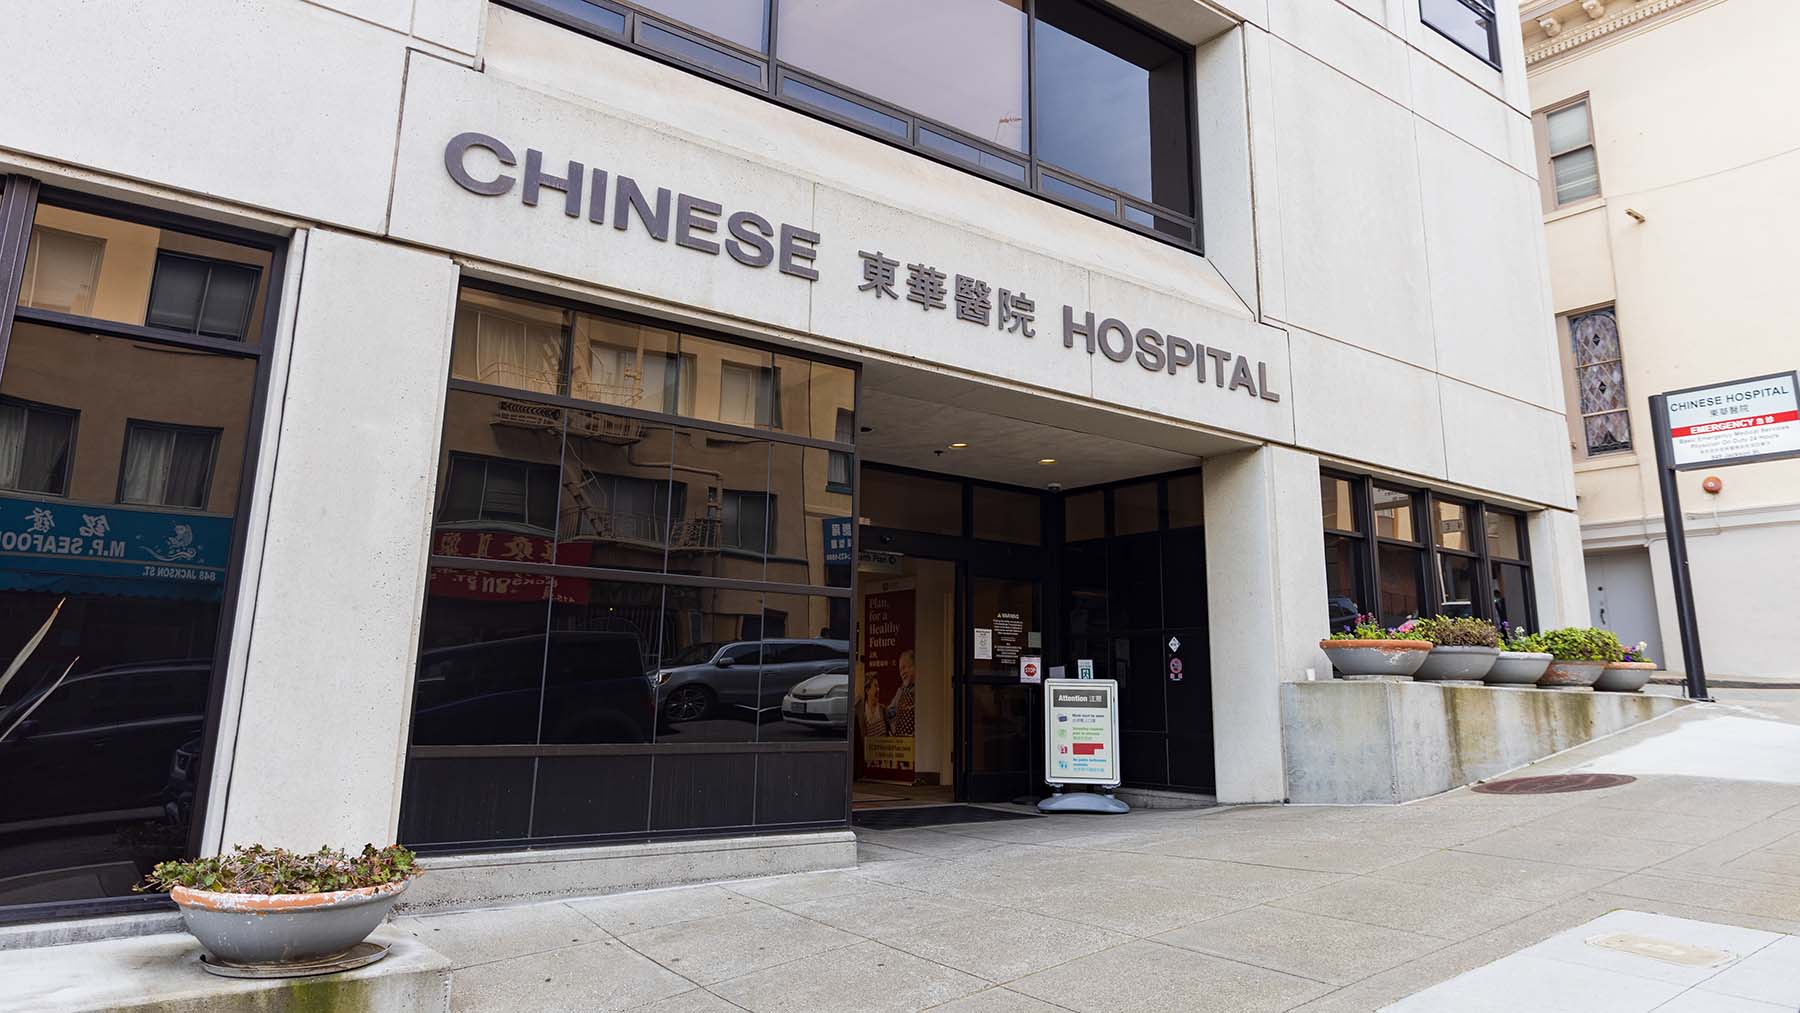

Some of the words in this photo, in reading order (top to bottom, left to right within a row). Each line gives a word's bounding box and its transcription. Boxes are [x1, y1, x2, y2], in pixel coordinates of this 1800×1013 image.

[444, 131, 821, 282] CHINESE
[858, 249, 1037, 338] 東華醫院
[1063, 305, 1280, 403] HOSPITAL
[1671, 396, 1723, 412] CHINESE
[1726, 386, 1788, 403] HOSPITAL
[1690, 419, 1753, 434] EMERGENCY
[869, 610, 881, 622] for
[882, 613, 888, 621] a
[869, 622, 902, 637] Healthy
[869, 637, 896, 648] Future
[1058, 694, 1088, 702] Attention
